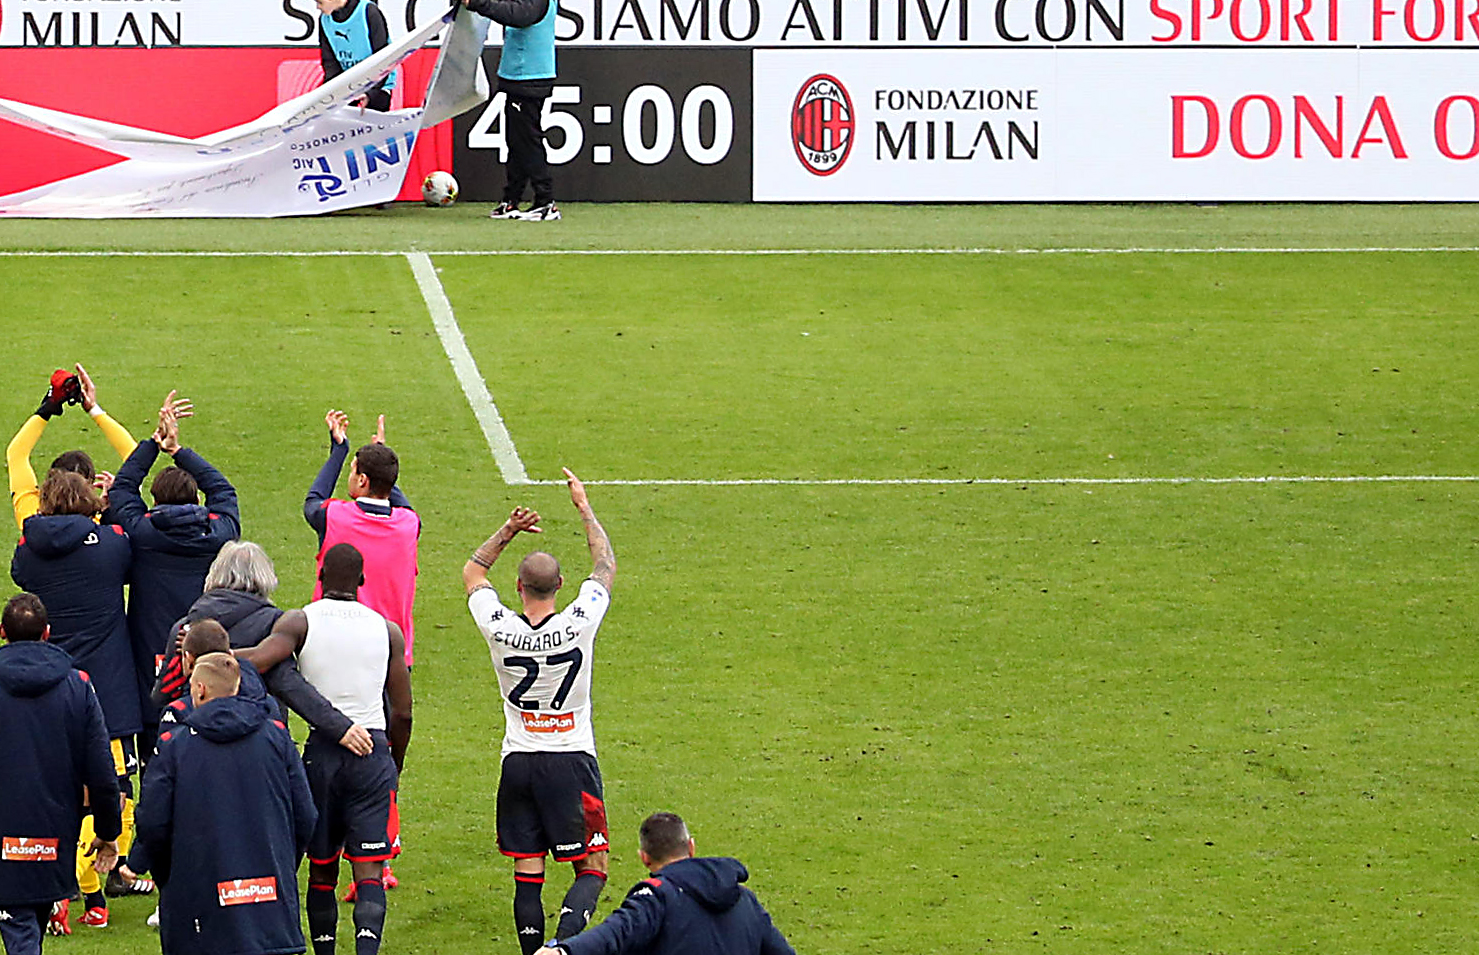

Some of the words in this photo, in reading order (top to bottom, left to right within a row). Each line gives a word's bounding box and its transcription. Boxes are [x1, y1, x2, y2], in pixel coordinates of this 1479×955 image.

[22, 11, 181, 46] MILAN
[806, 82, 841, 101] ACM
[875, 89, 1038, 110] FONDAZIONE
[468, 82, 735, 166] 45:00
[1170, 94, 1409, 160] DONA
[290, 132, 347, 152] CONOSCO
[875, 120, 1038, 161] MILAN
[292, 157, 314, 171] AIC
[808, 152, 838, 163] 1899
[494, 630, 562, 651] STURARO
[503, 646, 583, 711] 27
[523, 717, 572, 728] LeasePlan
[5, 842, 56, 855] LeasePlan
[221, 884, 274, 900] LeasePlan
